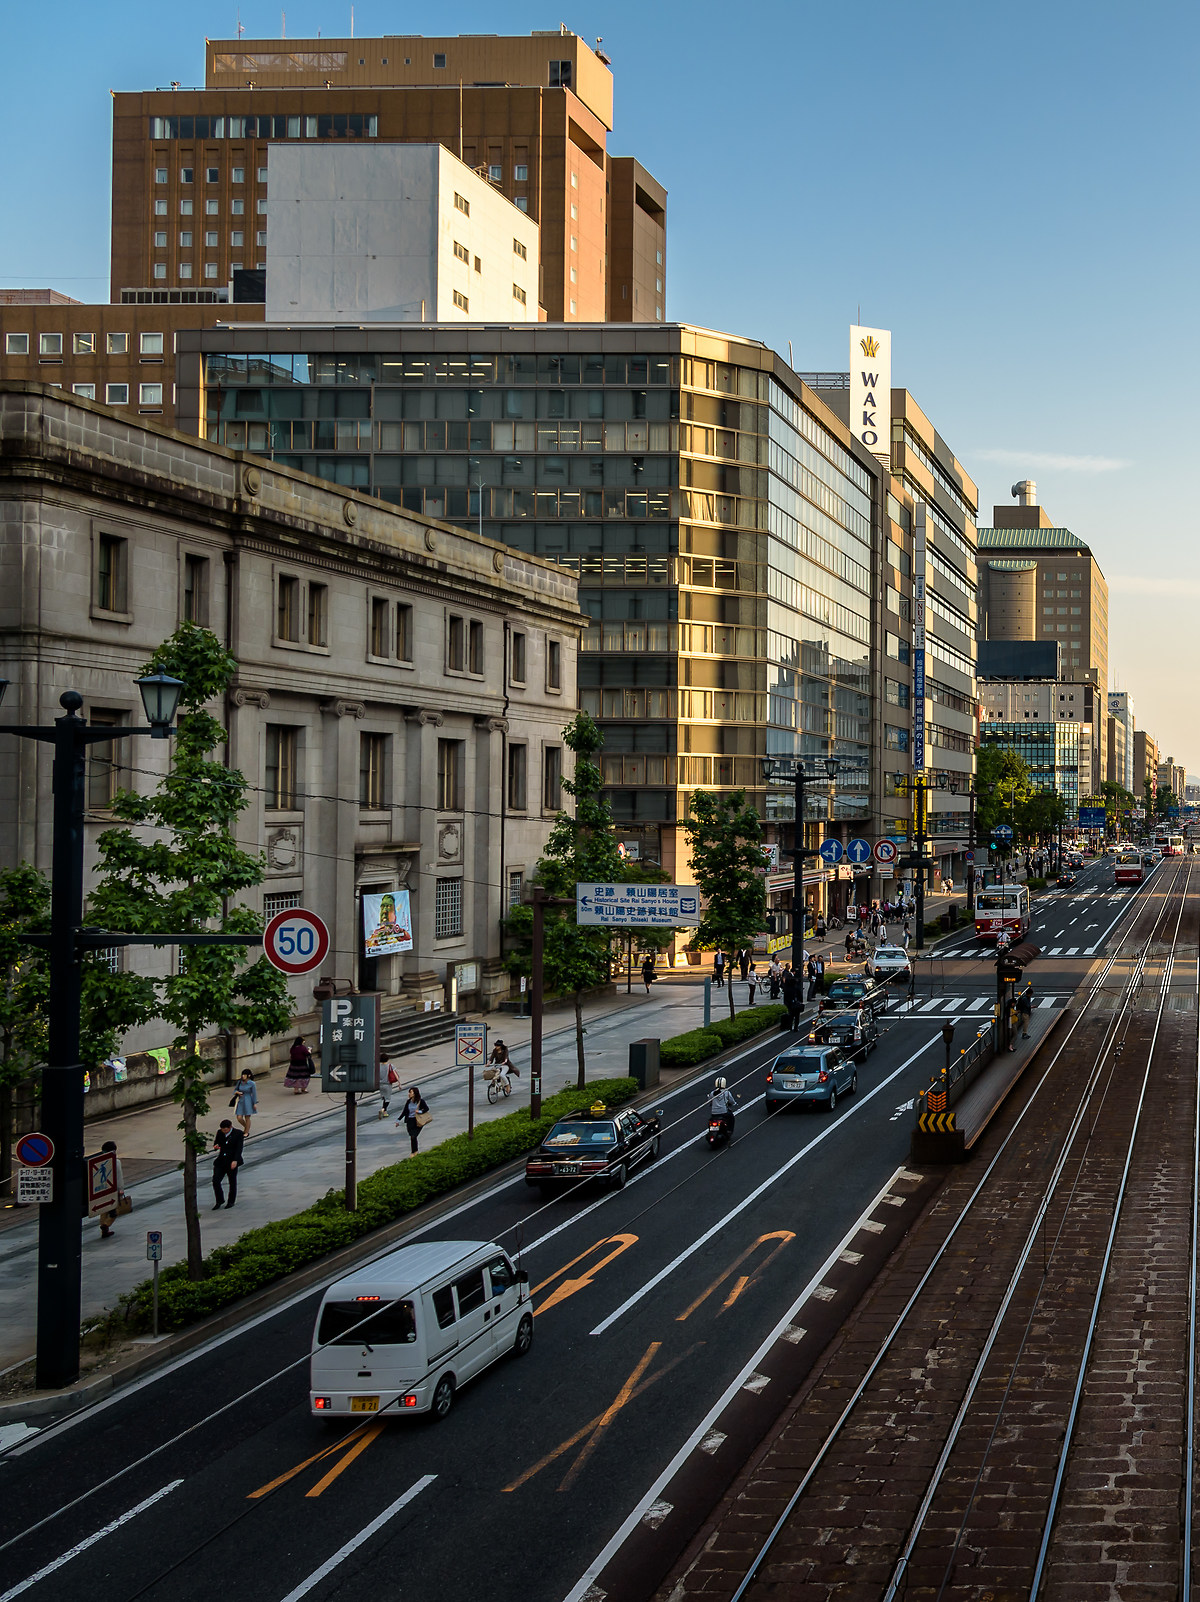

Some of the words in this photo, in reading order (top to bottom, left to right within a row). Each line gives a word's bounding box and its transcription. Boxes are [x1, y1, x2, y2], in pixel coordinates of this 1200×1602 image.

[861, 371, 879, 447] WAKO
[278, 927, 314, 956] 50
[330, 1000, 353, 1023] P
[342, 1017, 364, 1027] 案内
